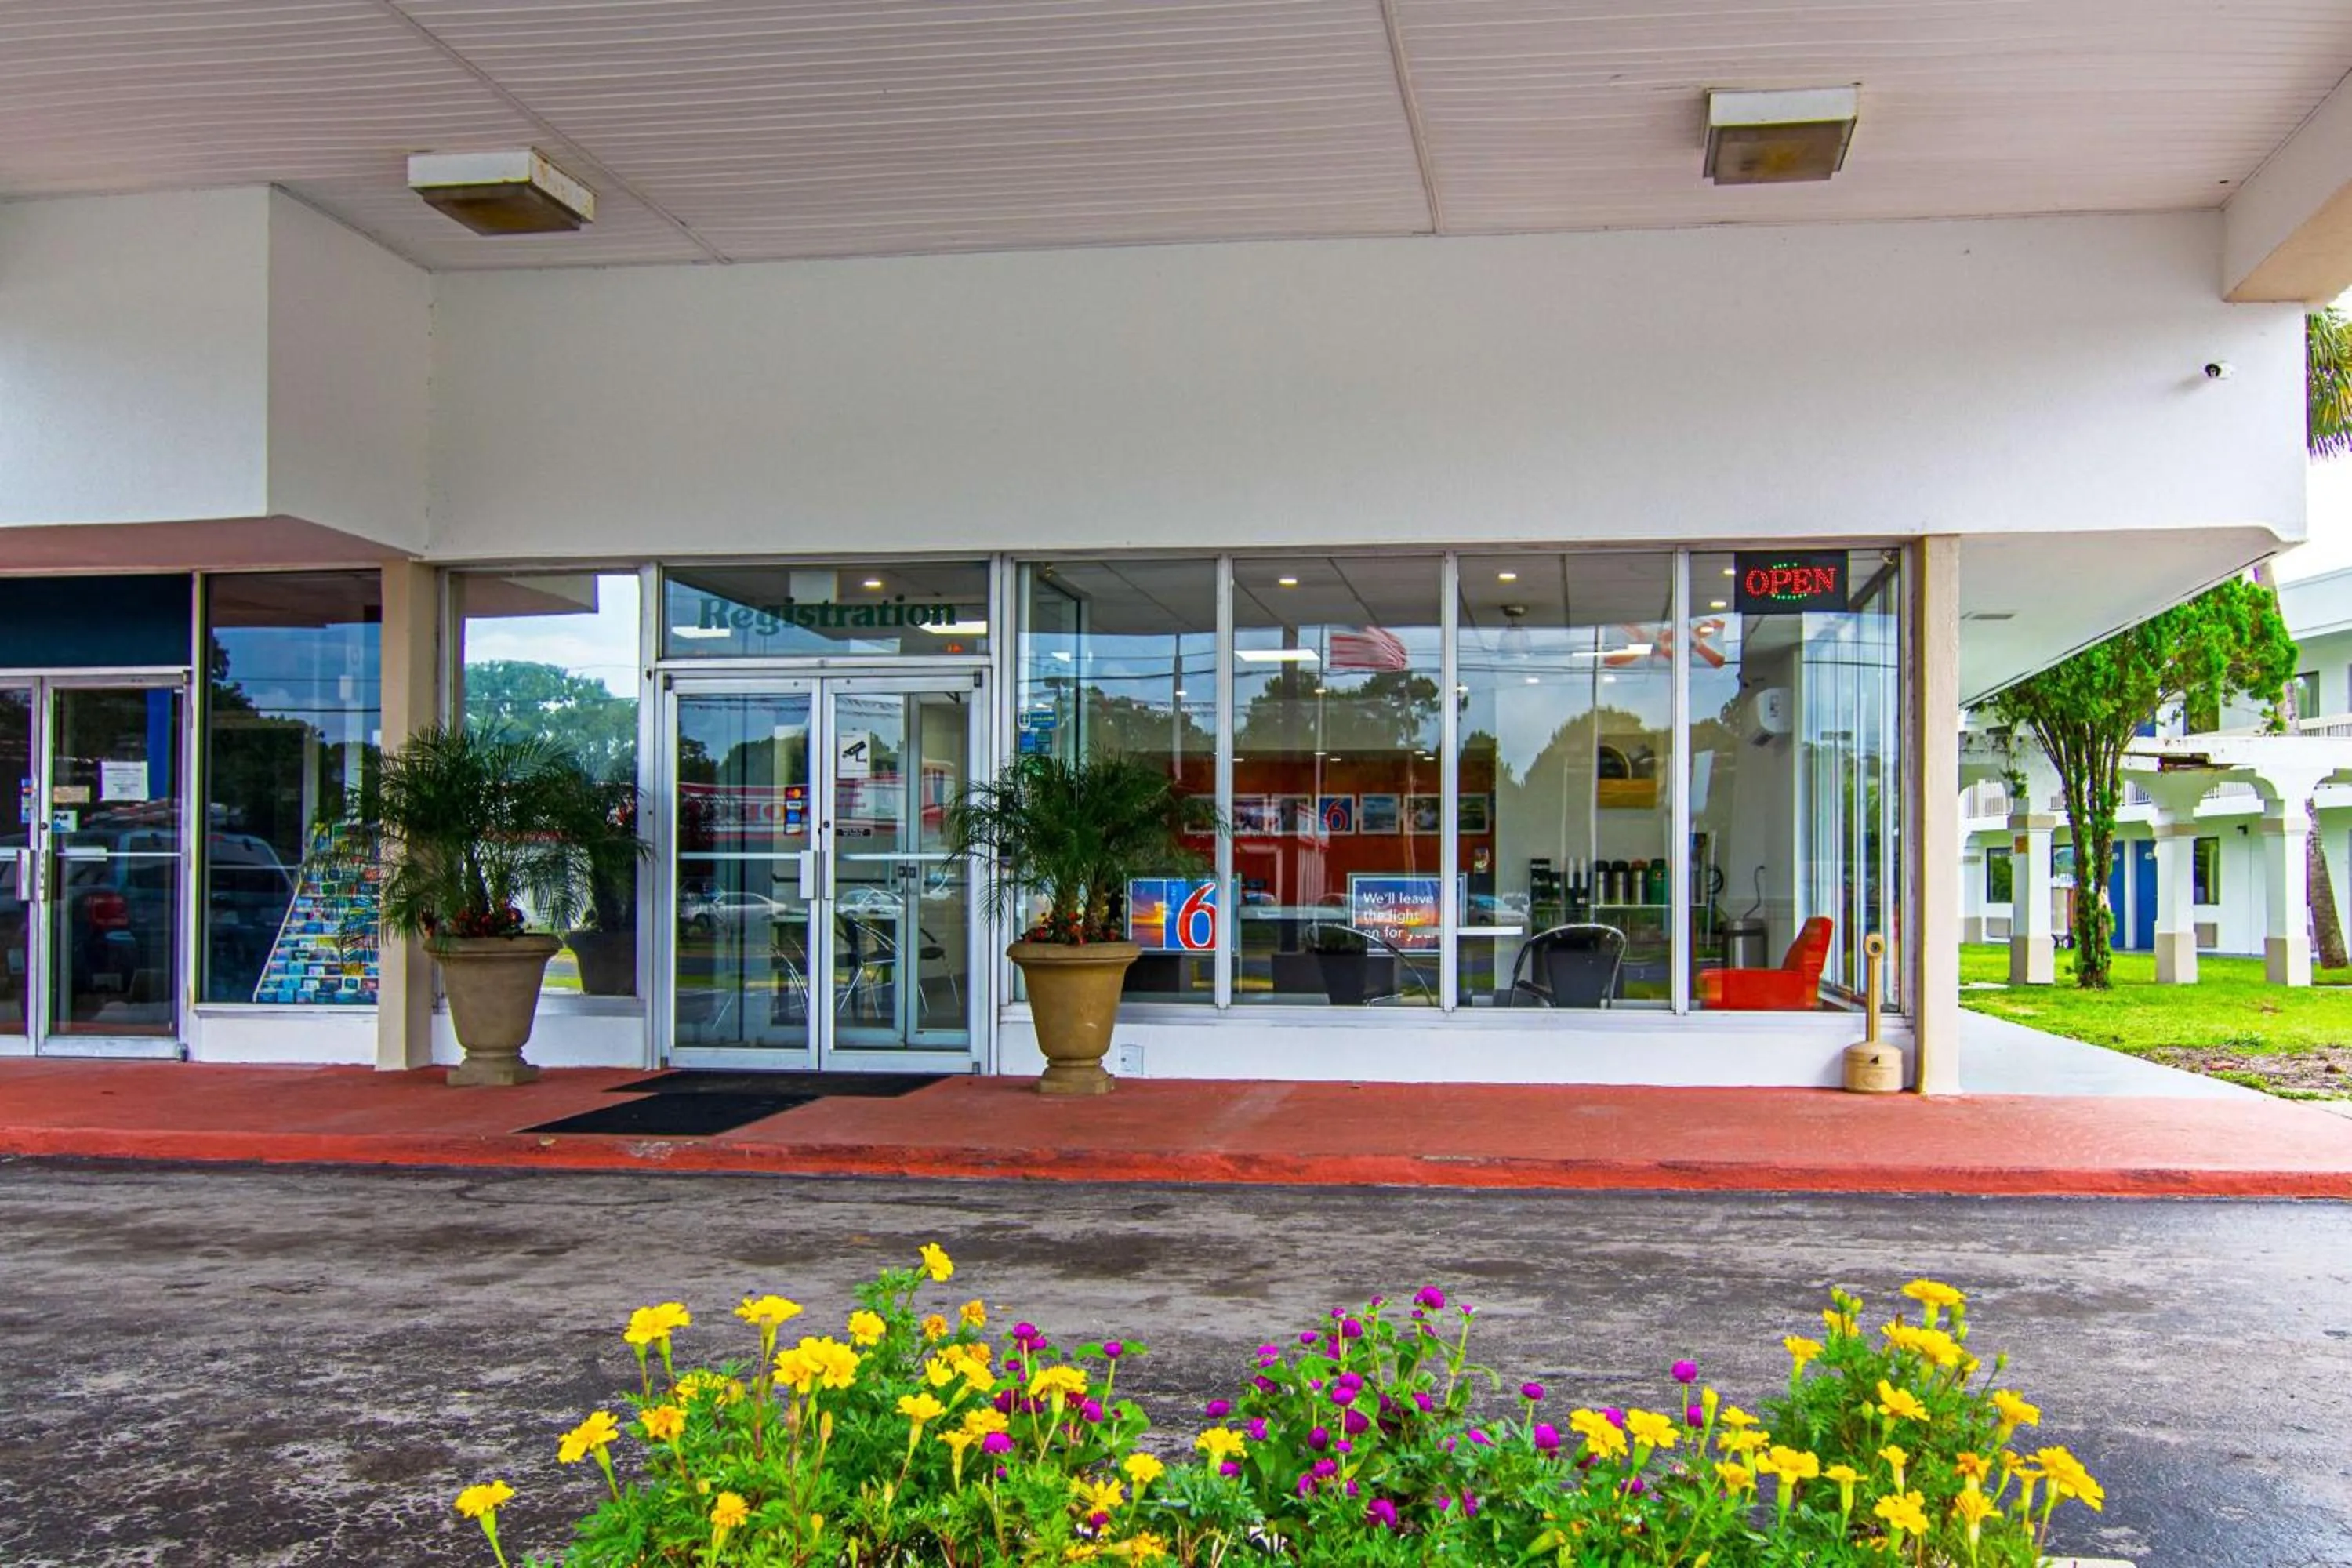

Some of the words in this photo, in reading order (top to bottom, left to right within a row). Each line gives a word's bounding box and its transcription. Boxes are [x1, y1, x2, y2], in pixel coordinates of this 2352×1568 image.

[1745, 567, 1837, 597] OPEN
[698, 595, 956, 636] Registration
[1324, 800, 1348, 831] 6
[1363, 891, 1395, 904] We'll
[1399, 891, 1433, 904] leave
[1177, 882, 1217, 950] 6
[1363, 909, 1385, 921] the
[1389, 908, 1419, 924] light
[1363, 929, 1380, 938] on
[1384, 926, 1404, 938] for
